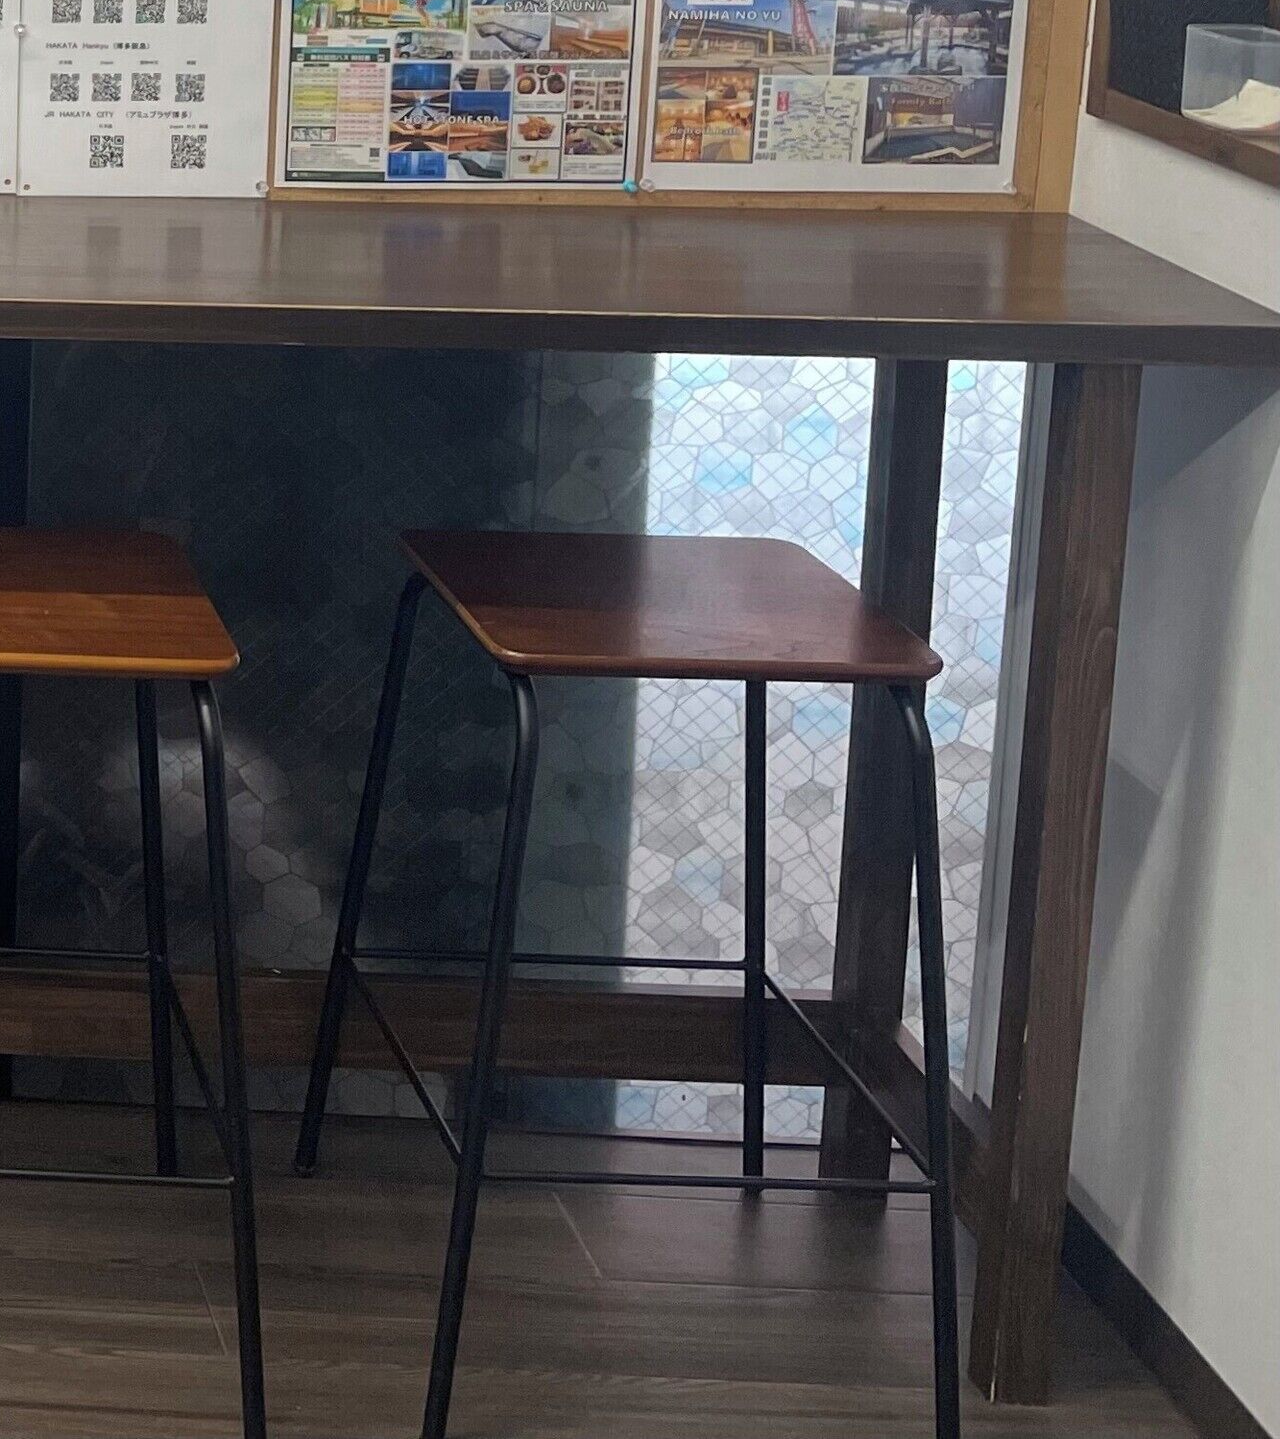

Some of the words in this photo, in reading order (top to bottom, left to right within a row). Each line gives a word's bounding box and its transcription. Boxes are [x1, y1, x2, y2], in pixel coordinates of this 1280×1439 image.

[668, 9, 733, 22] NAMIHA
[736, 10, 758, 22] NO
[762, 10, 781, 22] YU
[403, 115, 429, 126] HOT
[434, 116, 475, 126] STONE
[478, 116, 500, 125] SPA
